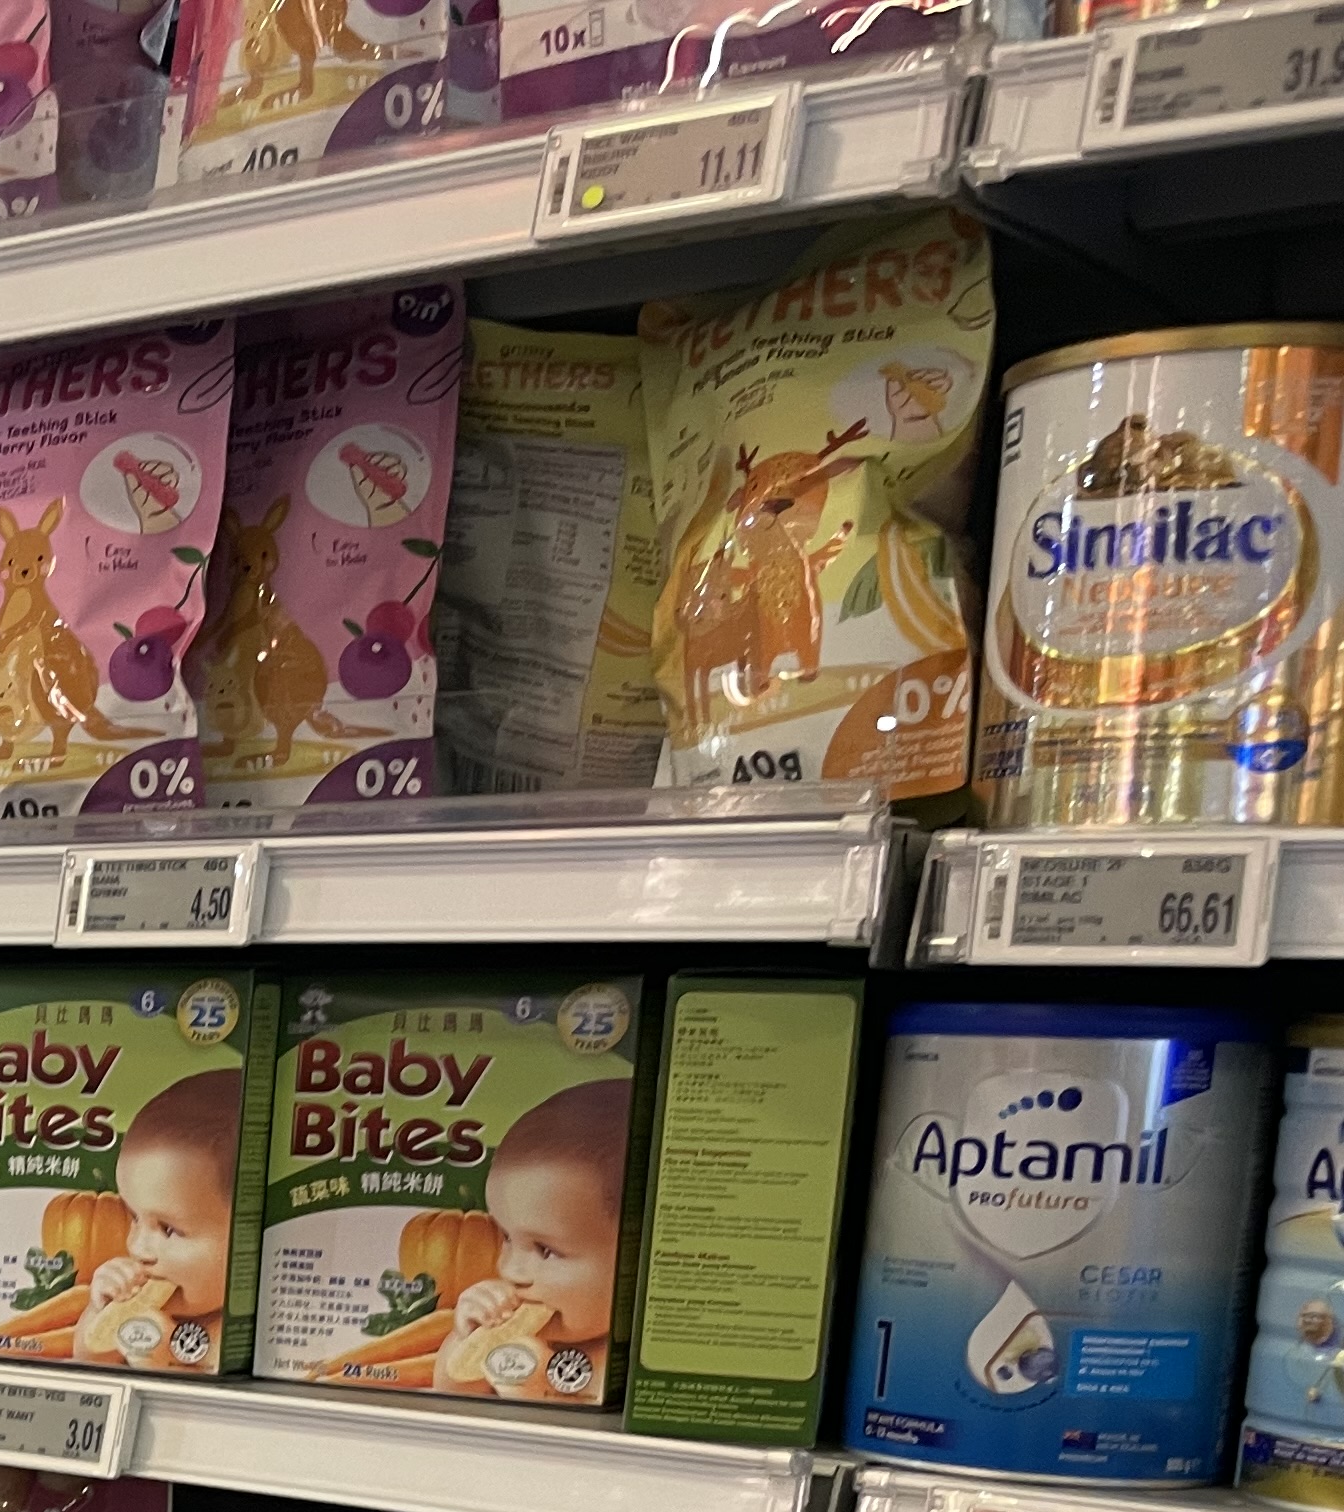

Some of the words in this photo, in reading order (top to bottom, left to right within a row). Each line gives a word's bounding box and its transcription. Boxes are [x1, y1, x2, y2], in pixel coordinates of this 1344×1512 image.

[540, 23, 588, 58] 10x
[382, 82, 446, 128] 0%
[696, 138, 765, 190] 11.11
[6, 419, 70, 446] Teething
[75, 409, 118, 433] Stick
[38, 430, 89, 453] Flavor
[1027, 500, 1286, 581] Similac
[892, 672, 969, 727] 0%
[128, 757, 197, 801] 0%
[355, 756, 424, 800] 0%
[731, 749, 803, 786] 40g
[189, 885, 233, 925] 4.50
[1157, 890, 1238, 936] 66.61
[189, 1003, 227, 1029] 25
[573, 1010, 614, 1038] 25
[294, 1036, 498, 1109] Baby
[288, 1101, 488, 1167] Bites
[912, 1120, 1170, 1203] Aptamil
[968, 1187, 1090, 1213] PROfutura
[342, 1361, 363, 1380] 24
[873, 1319, 894, 1400] 1
[64, 1418, 104, 1454] 3.01
